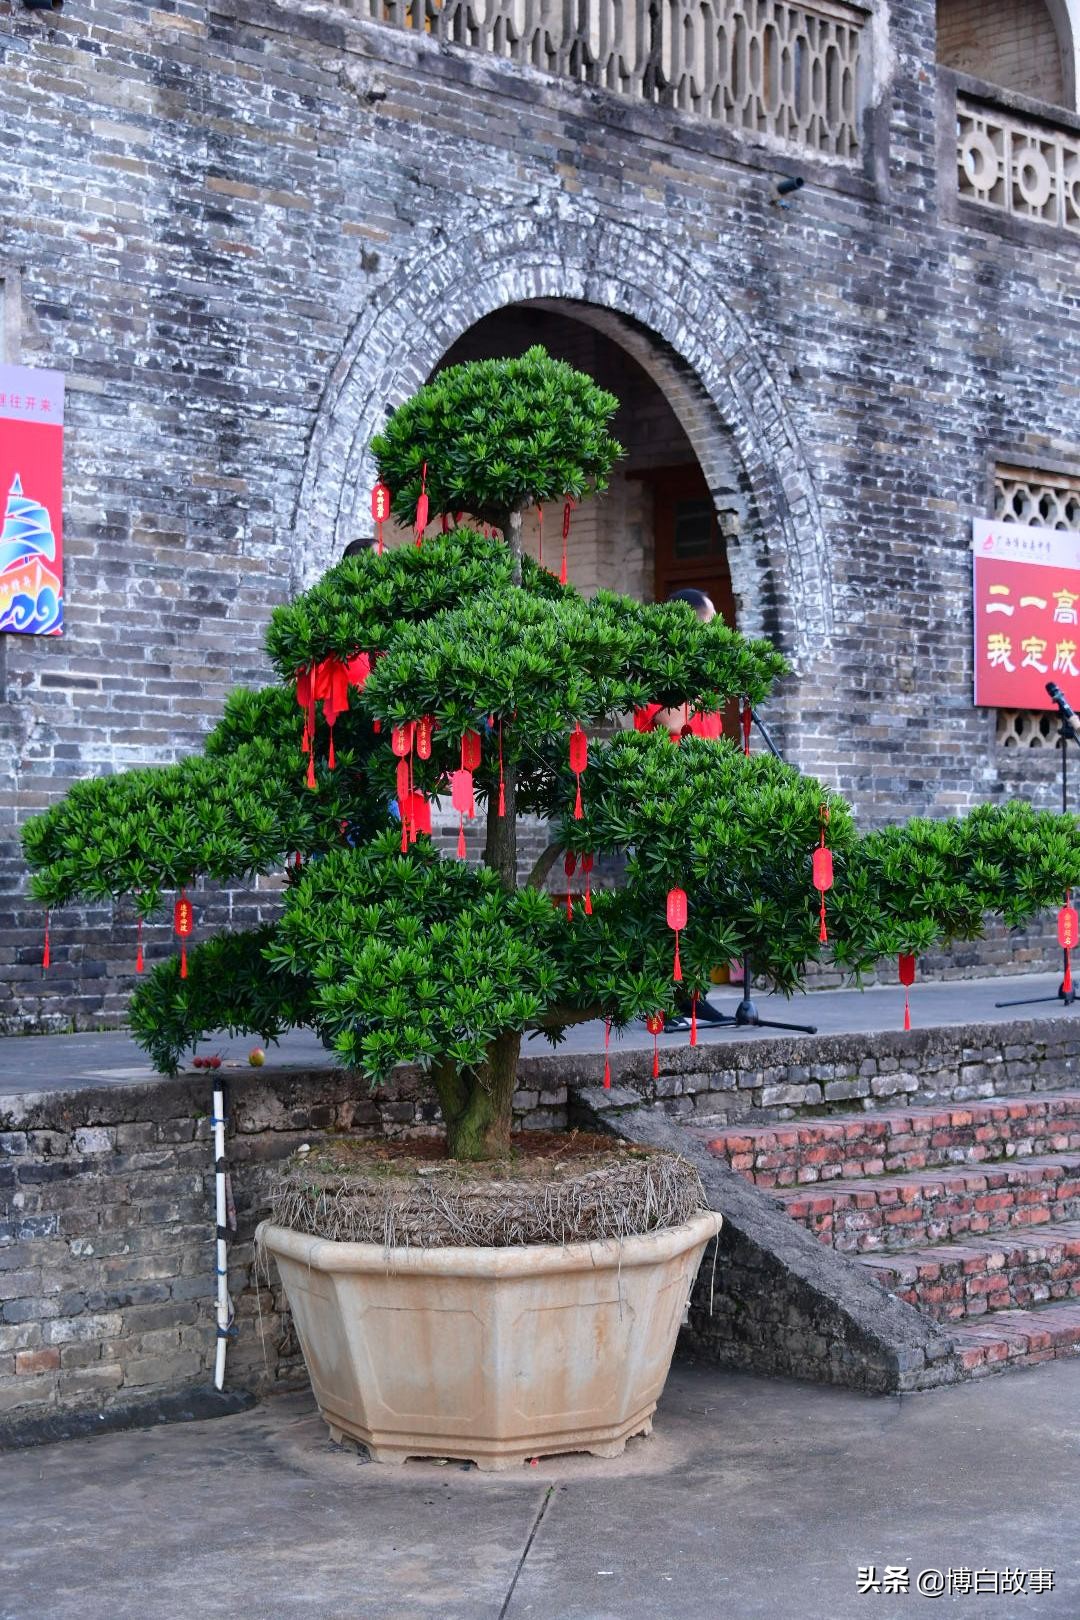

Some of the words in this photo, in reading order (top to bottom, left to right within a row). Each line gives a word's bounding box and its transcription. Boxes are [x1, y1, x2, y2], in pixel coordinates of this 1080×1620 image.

[985, 584, 1080, 625] 二一高
[986, 632, 1080, 677] 我定成
